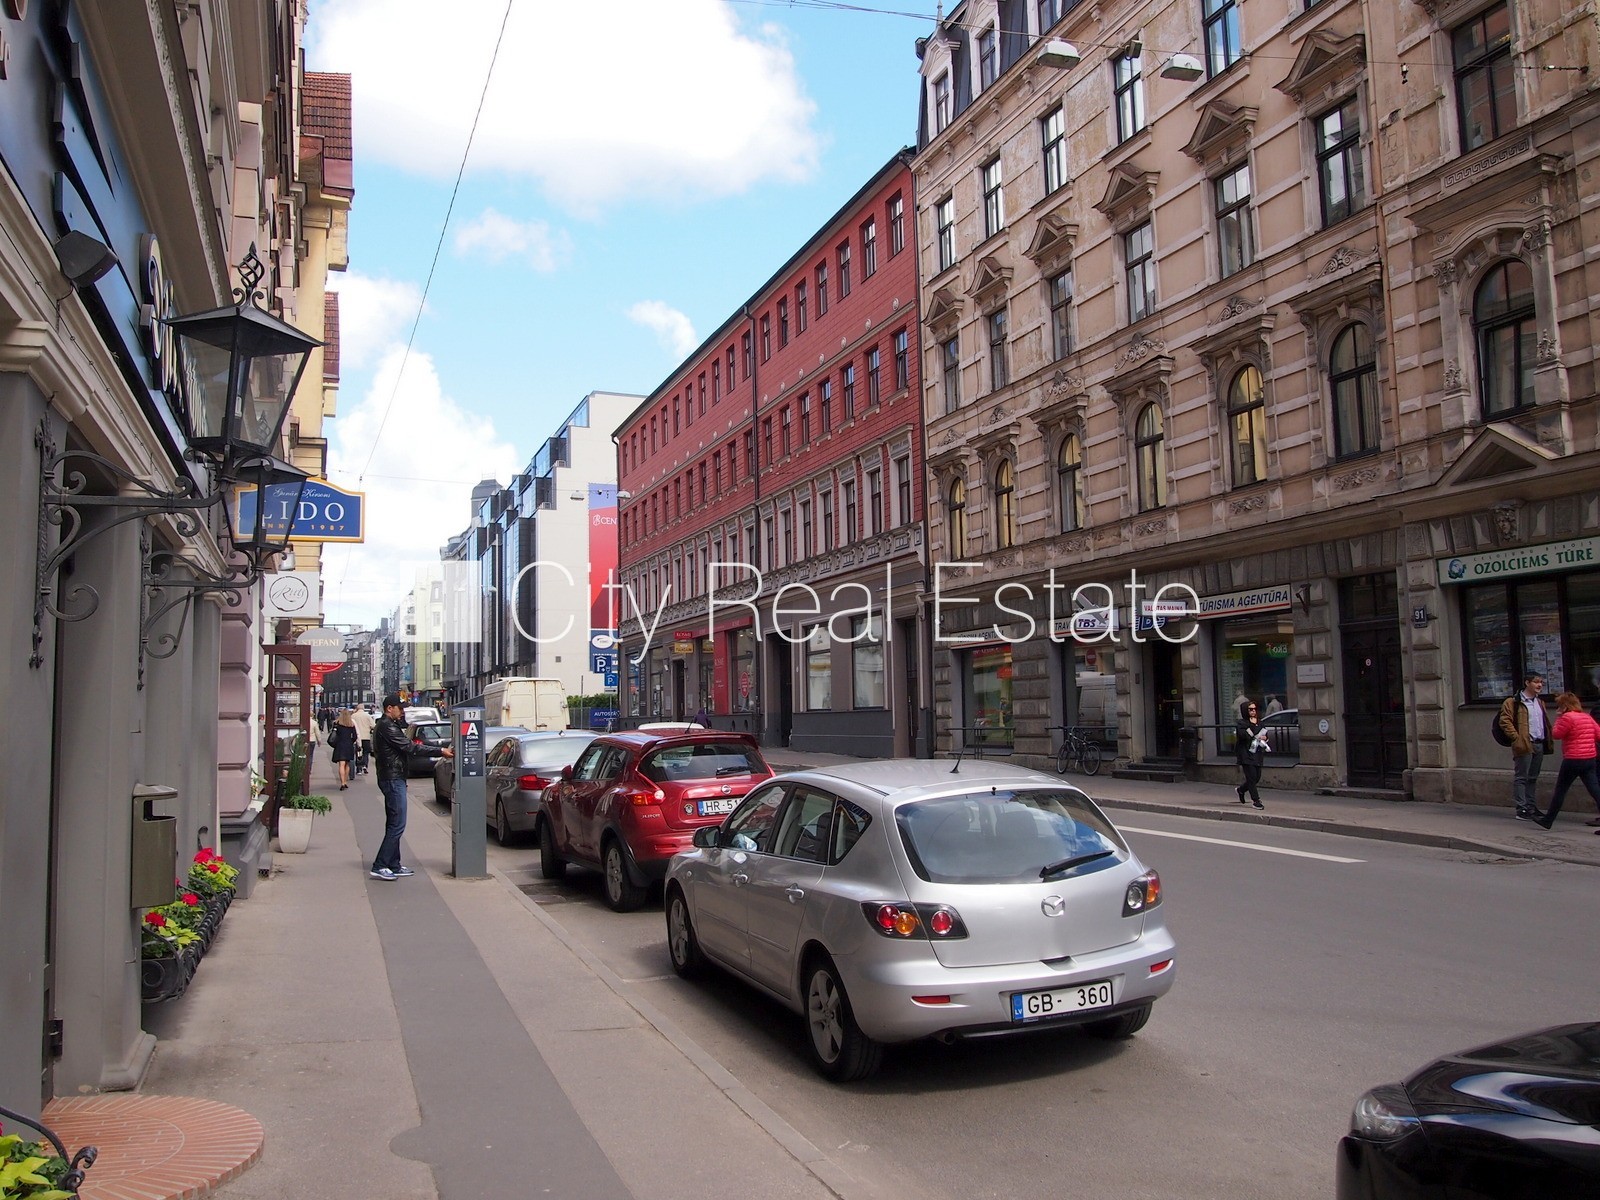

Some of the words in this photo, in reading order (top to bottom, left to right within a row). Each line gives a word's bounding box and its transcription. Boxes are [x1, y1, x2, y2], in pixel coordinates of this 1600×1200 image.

[310, 523, 345, 531] 1987
[1474, 553, 1549, 575] OZOLCIEMS
[1414, 609, 1425, 620] 91
[1078, 618, 1096, 628] TBS
[466, 722, 479, 735] A
[1077, 985, 1109, 1007] 360
